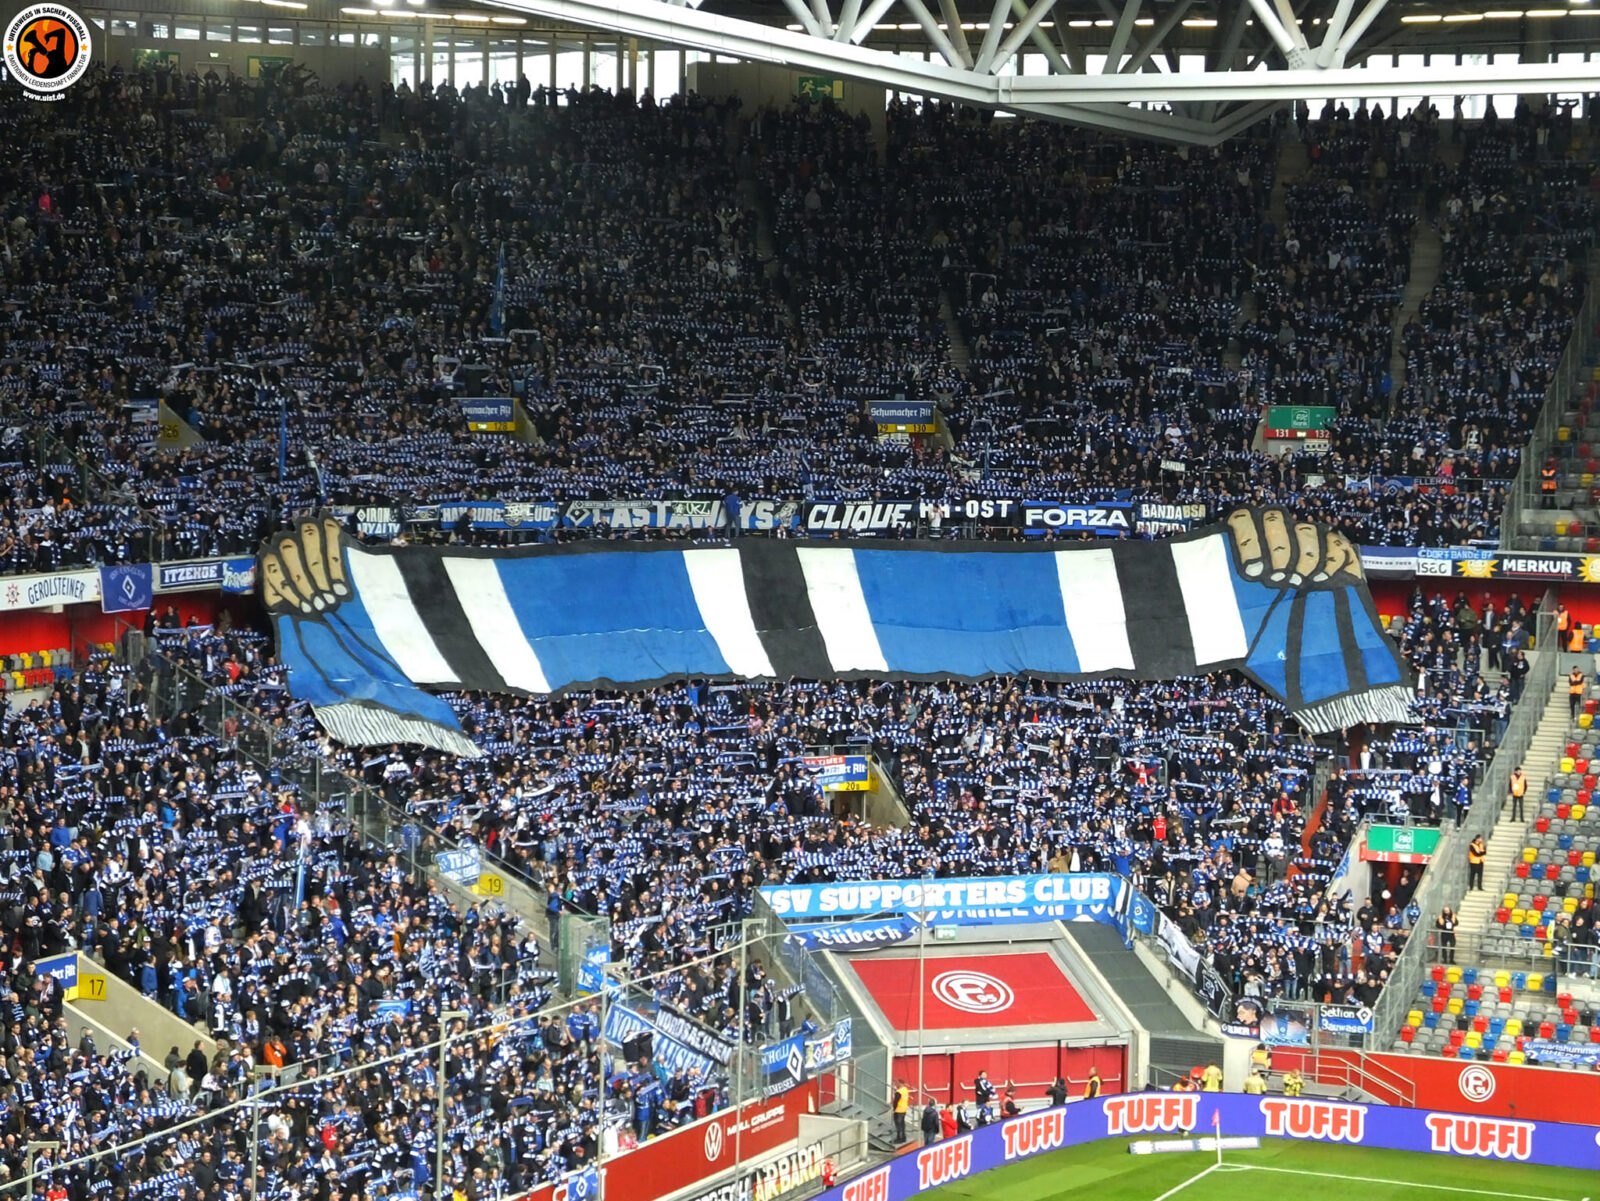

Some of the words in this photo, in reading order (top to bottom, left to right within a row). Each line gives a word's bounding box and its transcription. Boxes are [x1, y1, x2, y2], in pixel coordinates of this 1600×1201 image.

[870, 407, 918, 418] Schumacher
[919, 407, 931, 418] Alt
[1275, 428, 1289, 438] 131
[1315, 429, 1330, 439] 132
[1026, 509, 1129, 528] FORZA
[1142, 504, 1183, 520] BANDA
[164, 565, 218, 583] ITZEHOE
[1502, 558, 1573, 574] MERKUR
[27, 577, 86, 605] GEROLSTEINER
[1377, 851, 1388, 862] 21
[488, 878, 501, 893] 19
[820, 879, 1027, 912] SUPPORTERS
[1034, 878, 1111, 901] CLUB
[814, 925, 902, 947] Lübeck
[89, 978, 105, 996] 17
[1320, 1005, 1355, 1018] Sektion
[1321, 1019, 1367, 1033] Bauwagen
[655, 1009, 733, 1065] NORDSACHSEN
[1106, 1097, 1193, 1131] TUFFI
[1263, 1101, 1361, 1140] TUFFI
[1003, 1112, 1063, 1156] TUFFI
[1429, 1116, 1528, 1157] TUFFI
[919, 1138, 969, 1187] TUFFI
